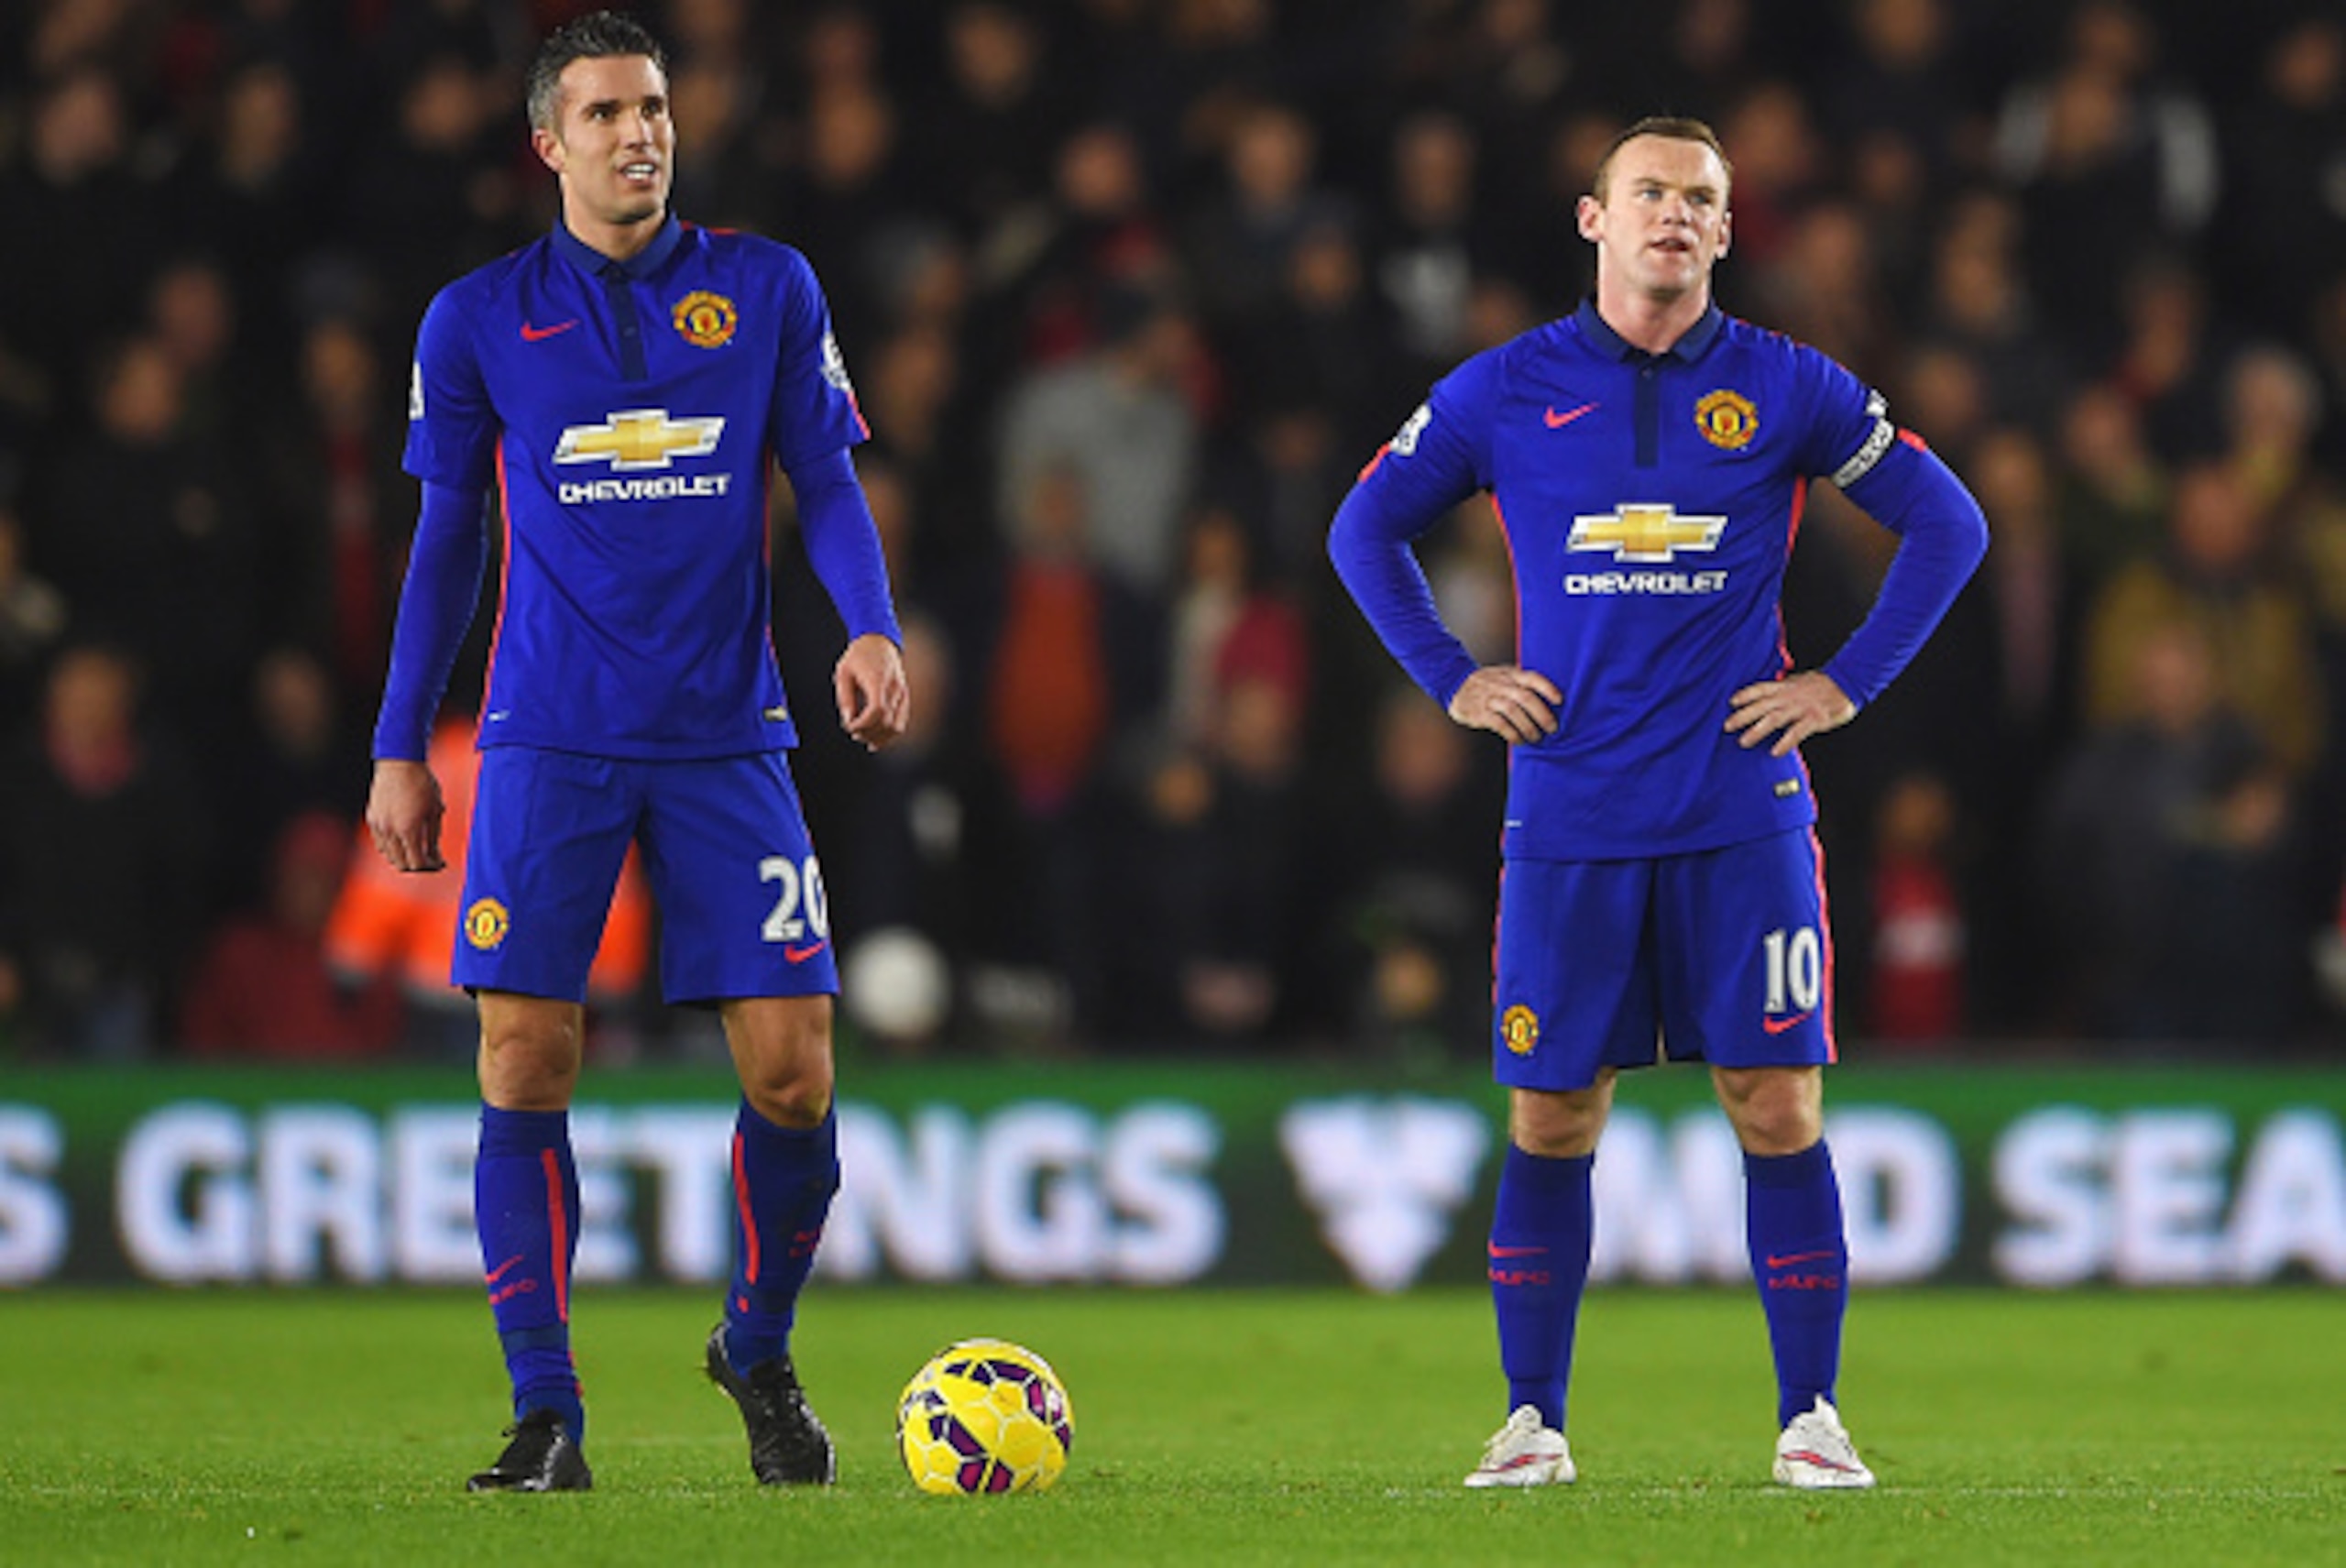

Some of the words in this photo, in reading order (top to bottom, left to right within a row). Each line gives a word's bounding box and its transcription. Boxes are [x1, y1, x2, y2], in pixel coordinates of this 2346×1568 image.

[558, 474, 731, 504] CHEVROLET
[1564, 571, 1728, 595] CHEVROLET
[759, 855, 827, 941] 20
[1763, 927, 1820, 1014] 10
[117, 1100, 1225, 1283] GREETNGS
[1589, 1106, 1961, 1285] MD
